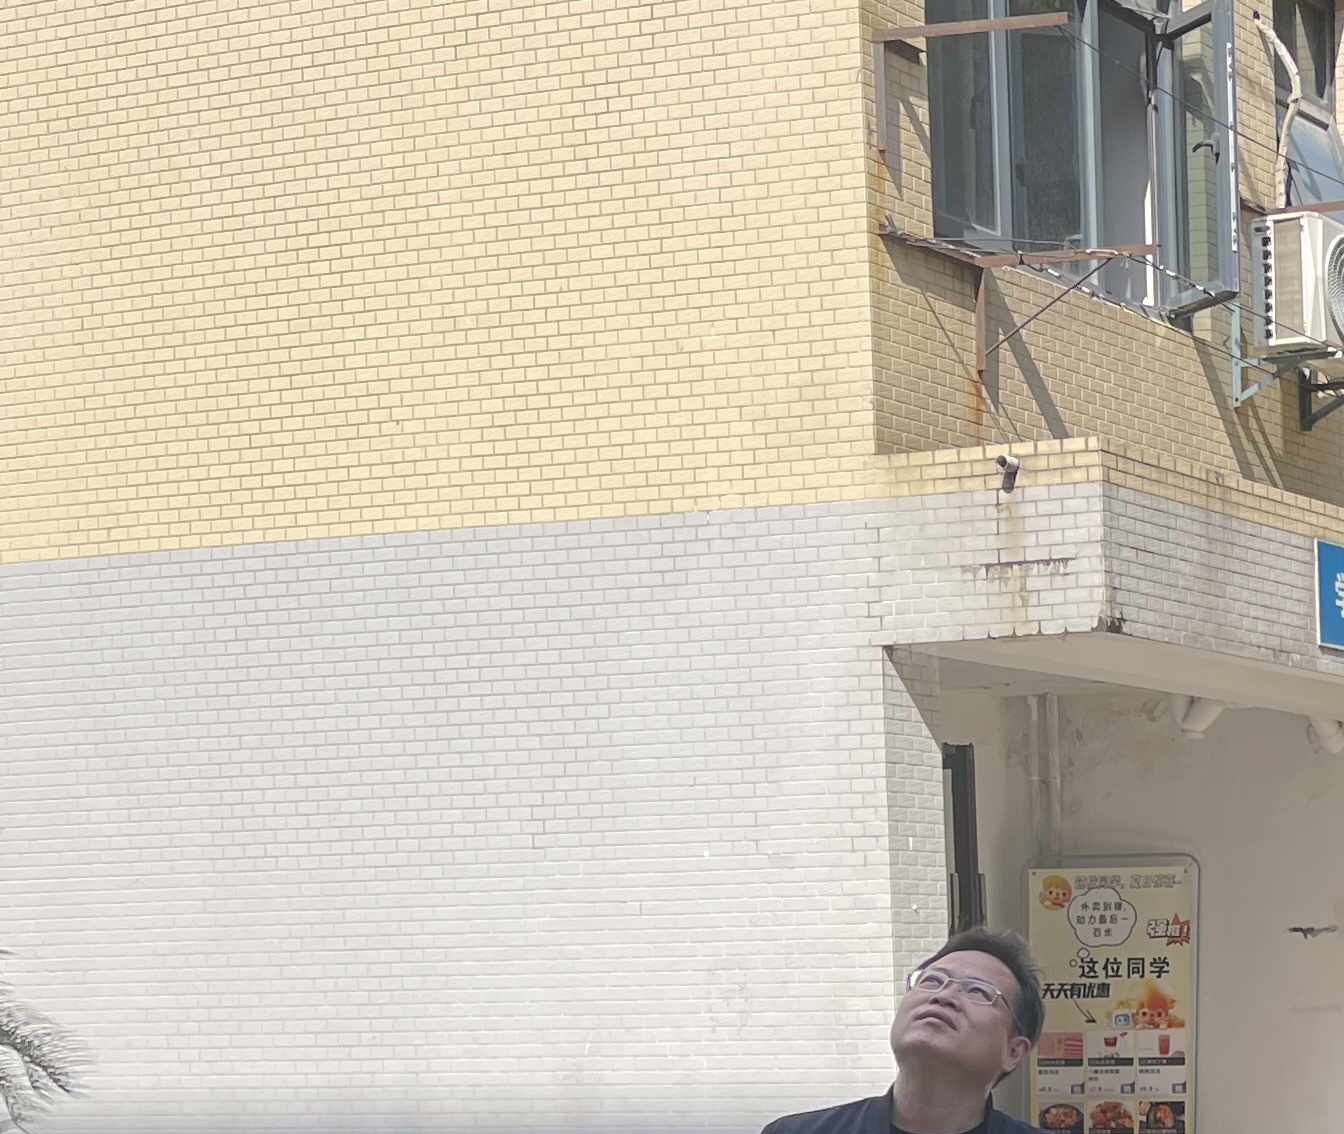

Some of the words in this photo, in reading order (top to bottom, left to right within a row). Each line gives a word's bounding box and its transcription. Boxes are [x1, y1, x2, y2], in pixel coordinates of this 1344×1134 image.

[1079, 957, 1170, 979] 这位同学
[1042, 982, 1111, 999] 天天有优惠
